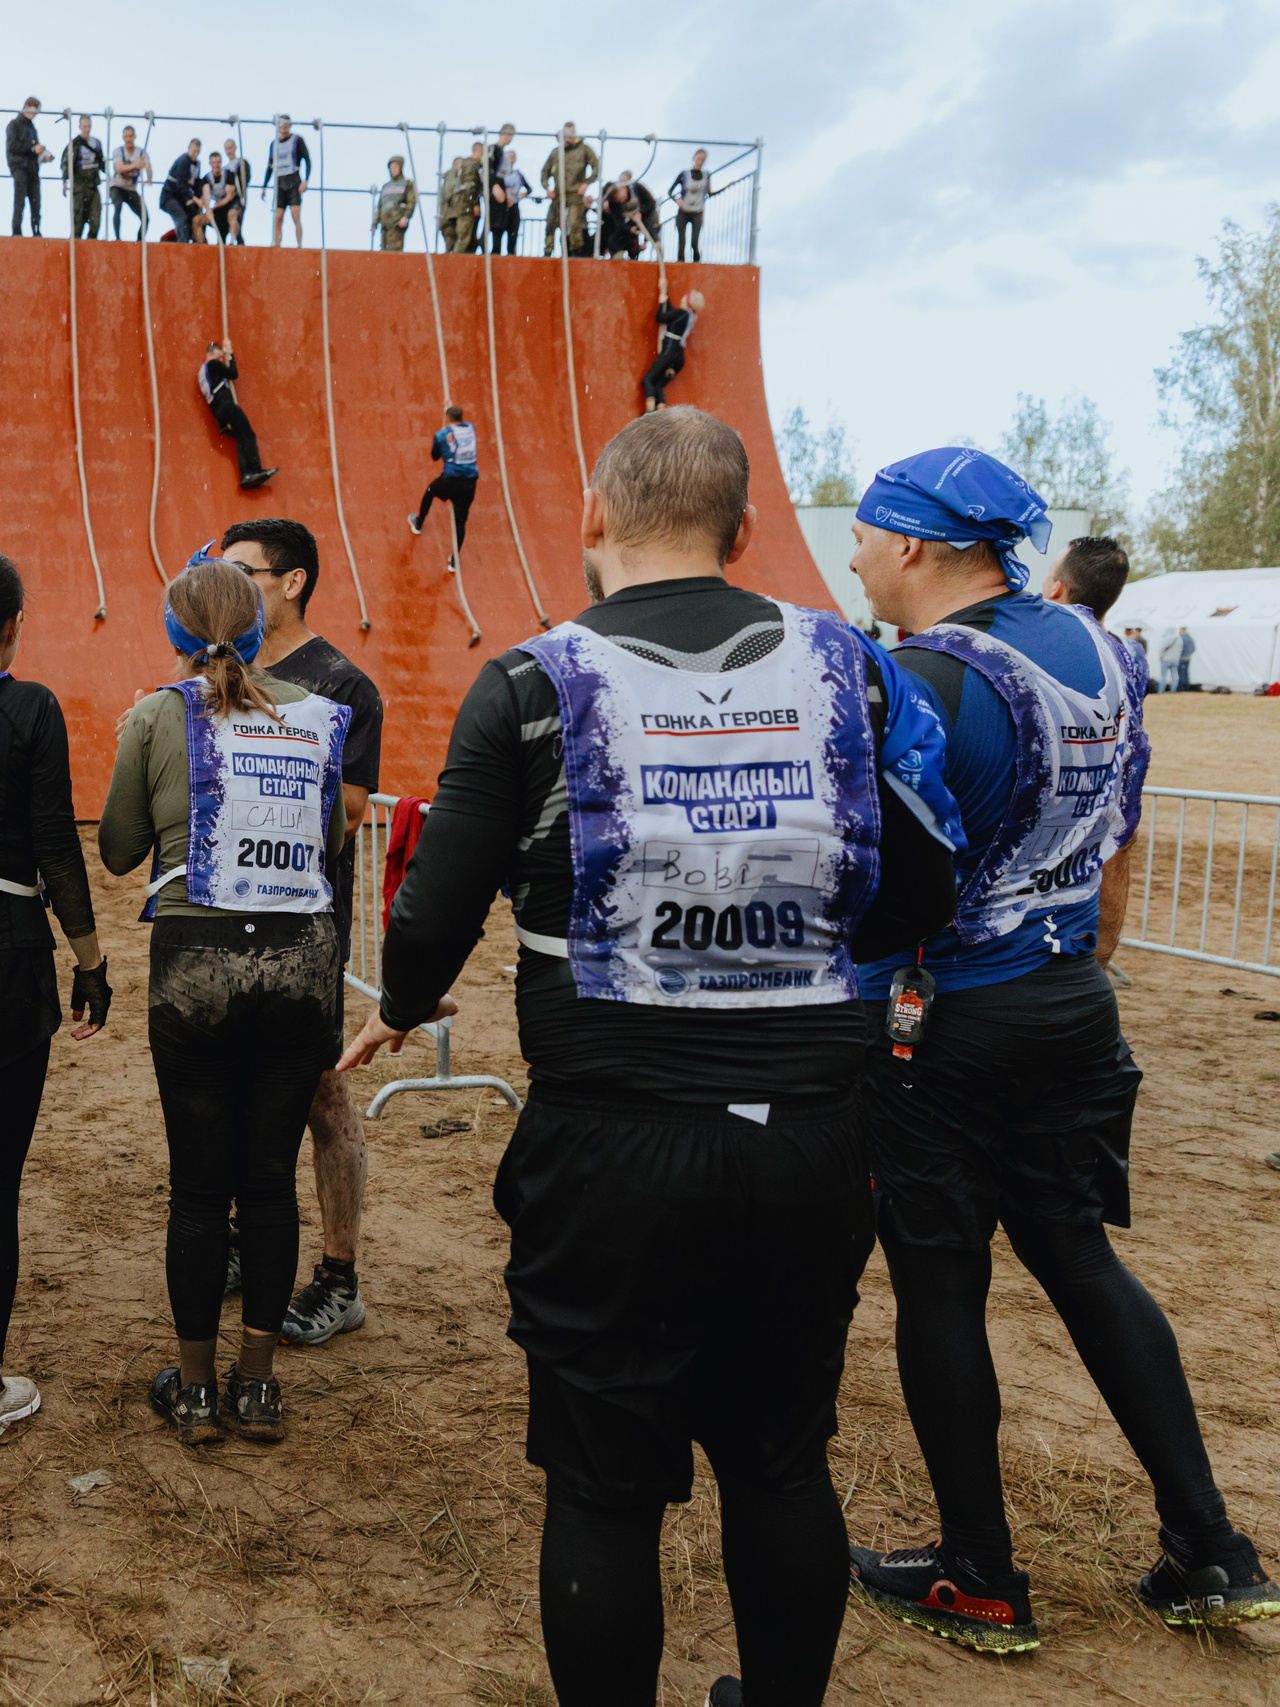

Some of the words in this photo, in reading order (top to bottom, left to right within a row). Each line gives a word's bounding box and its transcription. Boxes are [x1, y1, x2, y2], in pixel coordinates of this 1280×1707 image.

[889, 518, 947, 537] Стоматология
[891, 511, 921, 525] Нежная
[641, 713, 714, 730] ГОНКА
[719, 708, 799, 728] ГЕРОЕВ
[233, 723, 275, 736] ГОНКА
[278, 725, 319, 742] ГЕРОЕВ
[234, 755, 319, 783] КОМАНДНЫЙ
[262, 777, 303, 798] СТАРТ
[645, 760, 810, 801] КОМАНДНЫЙ
[246, 805, 304, 833] САША
[691, 800, 770, 830] СТАРТ
[237, 837, 315, 873] 20007
[257, 884, 320, 899] ГАЗПРОМБАНК
[650, 900, 805, 951] 20009
[698, 969, 813, 991] ГАЗПРОМБАНК
[895, 1003, 923, 1016] STRONG
